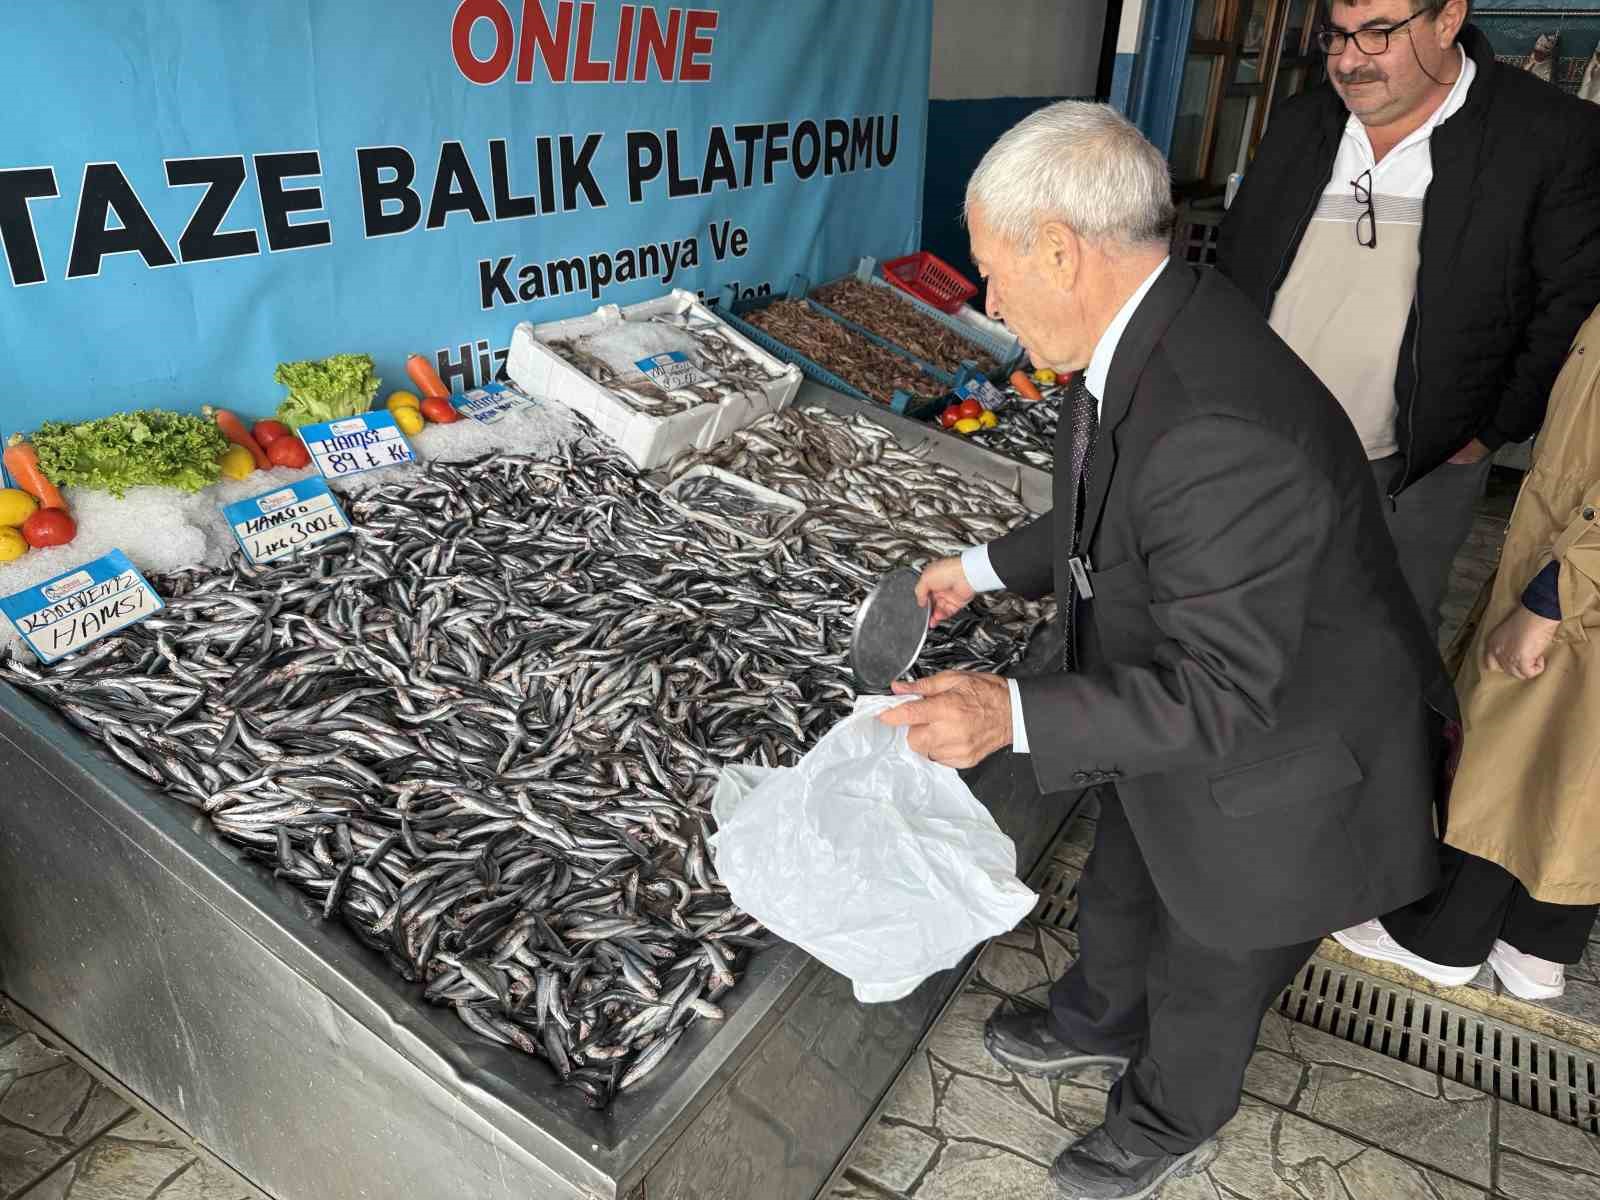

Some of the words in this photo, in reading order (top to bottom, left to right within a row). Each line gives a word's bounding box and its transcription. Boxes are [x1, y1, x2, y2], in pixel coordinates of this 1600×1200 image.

[451, 0, 719, 86] ONLINE
[0, 150, 332, 287] TAZE
[355, 133, 608, 239] BALIK
[626, 113, 901, 204] PLATFORMU
[479, 235, 699, 312] Kampanya
[708, 219, 749, 261] Ve
